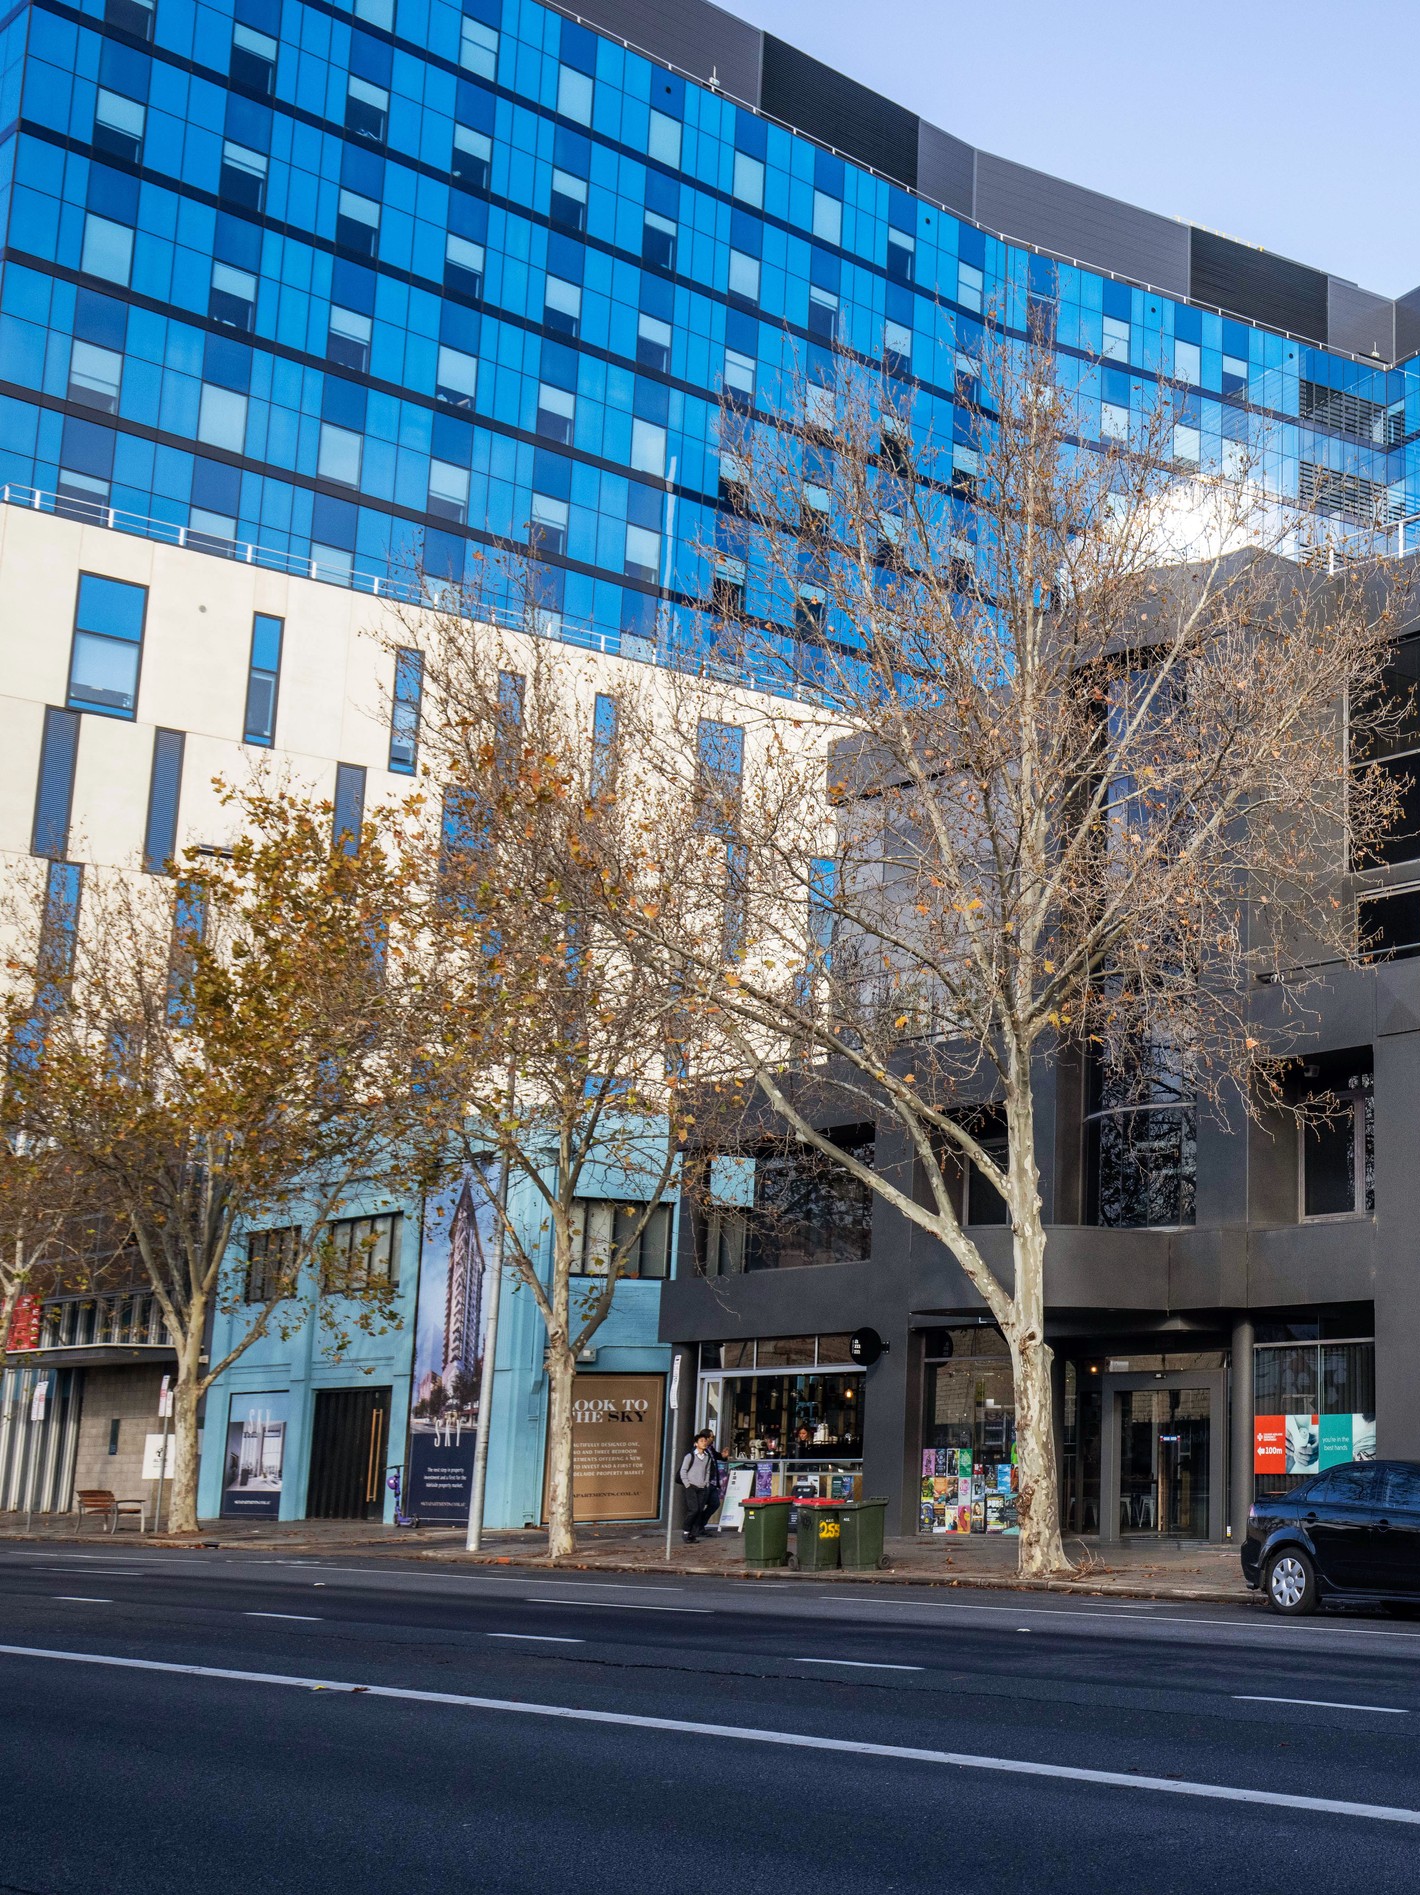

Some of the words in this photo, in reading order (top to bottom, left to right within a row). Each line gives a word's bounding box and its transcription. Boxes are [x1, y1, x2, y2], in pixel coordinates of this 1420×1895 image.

[573, 1400, 616, 1411] OOK
[622, 1400, 648, 1411] TO
[608, 1411, 646, 1422] SKY
